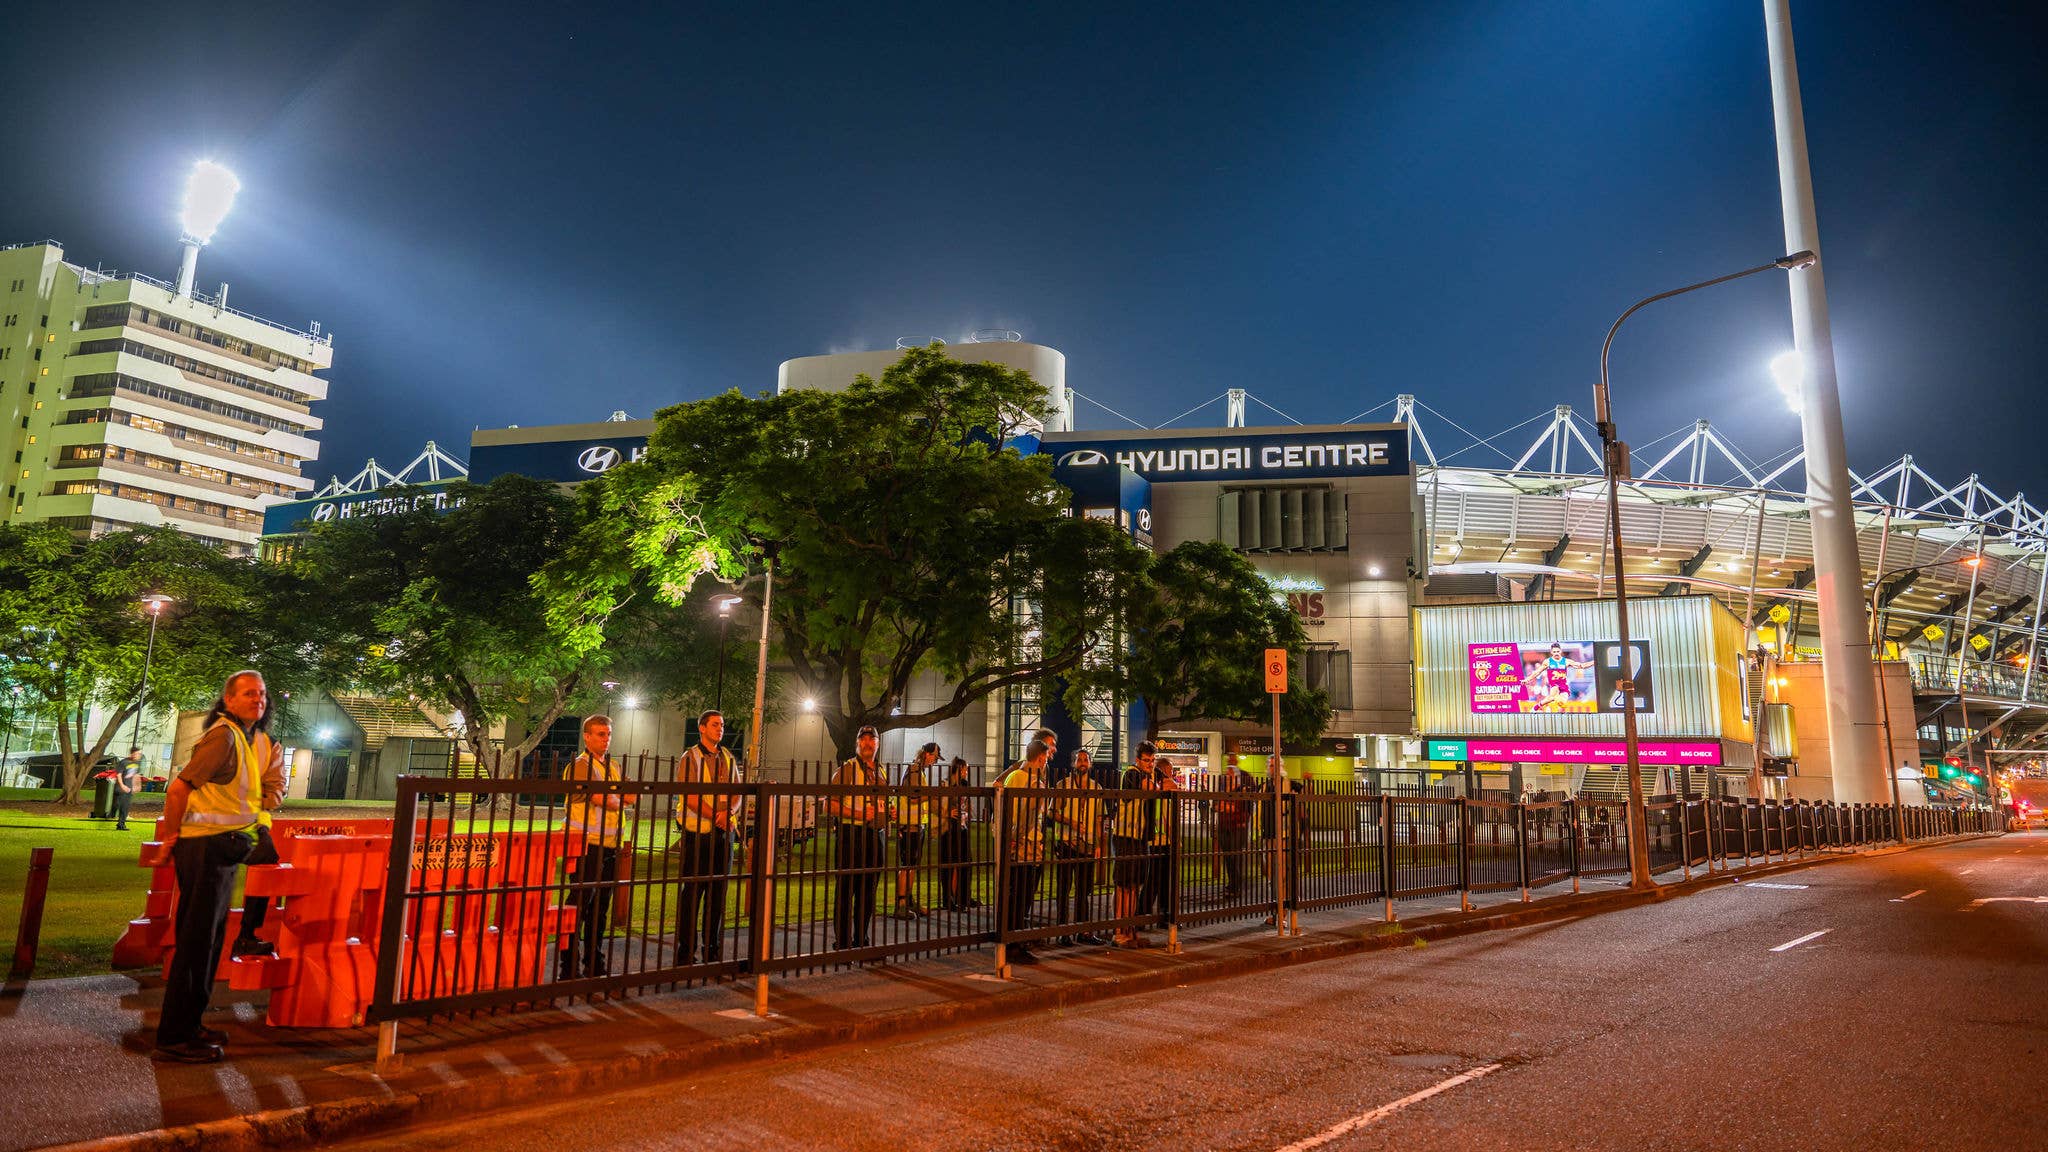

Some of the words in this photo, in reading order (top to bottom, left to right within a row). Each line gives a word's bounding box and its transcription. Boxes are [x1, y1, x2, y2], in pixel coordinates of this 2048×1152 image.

[1116, 447, 1250, 472] HYUNDAI
[1261, 443, 1389, 468] CENTRE
[1475, 686, 1504, 694] SATURDAY
[1509, 685, 1521, 693] MAY
[1240, 745, 1261, 753] Ticket
[449, 843, 495, 853] SYSEMS
